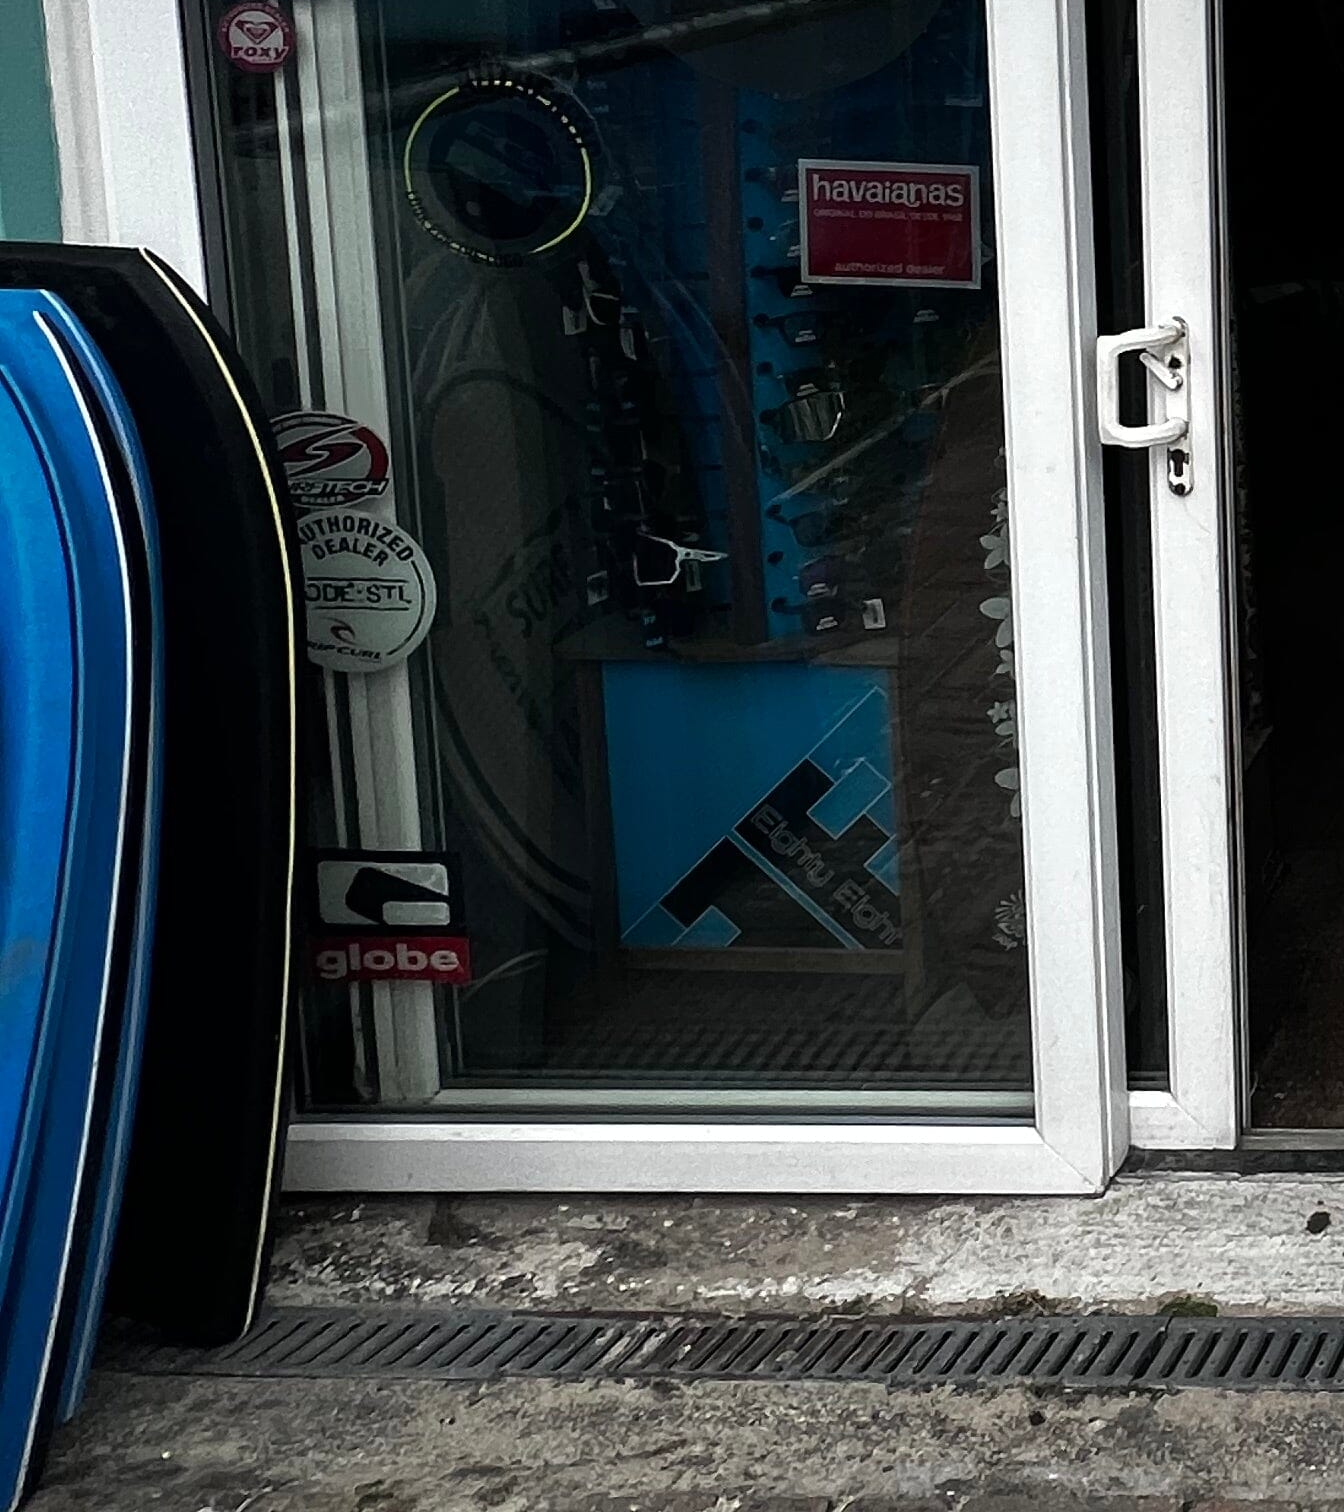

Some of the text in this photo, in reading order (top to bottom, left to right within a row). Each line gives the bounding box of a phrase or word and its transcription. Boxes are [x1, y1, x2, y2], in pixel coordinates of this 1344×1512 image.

[812, 174, 964, 207] havaianas
[834, 262, 903, 274] authorized
[312, 537, 388, 567] DEALER
[751, 804, 835, 888] Eighty
[316, 942, 460, 980] globe
